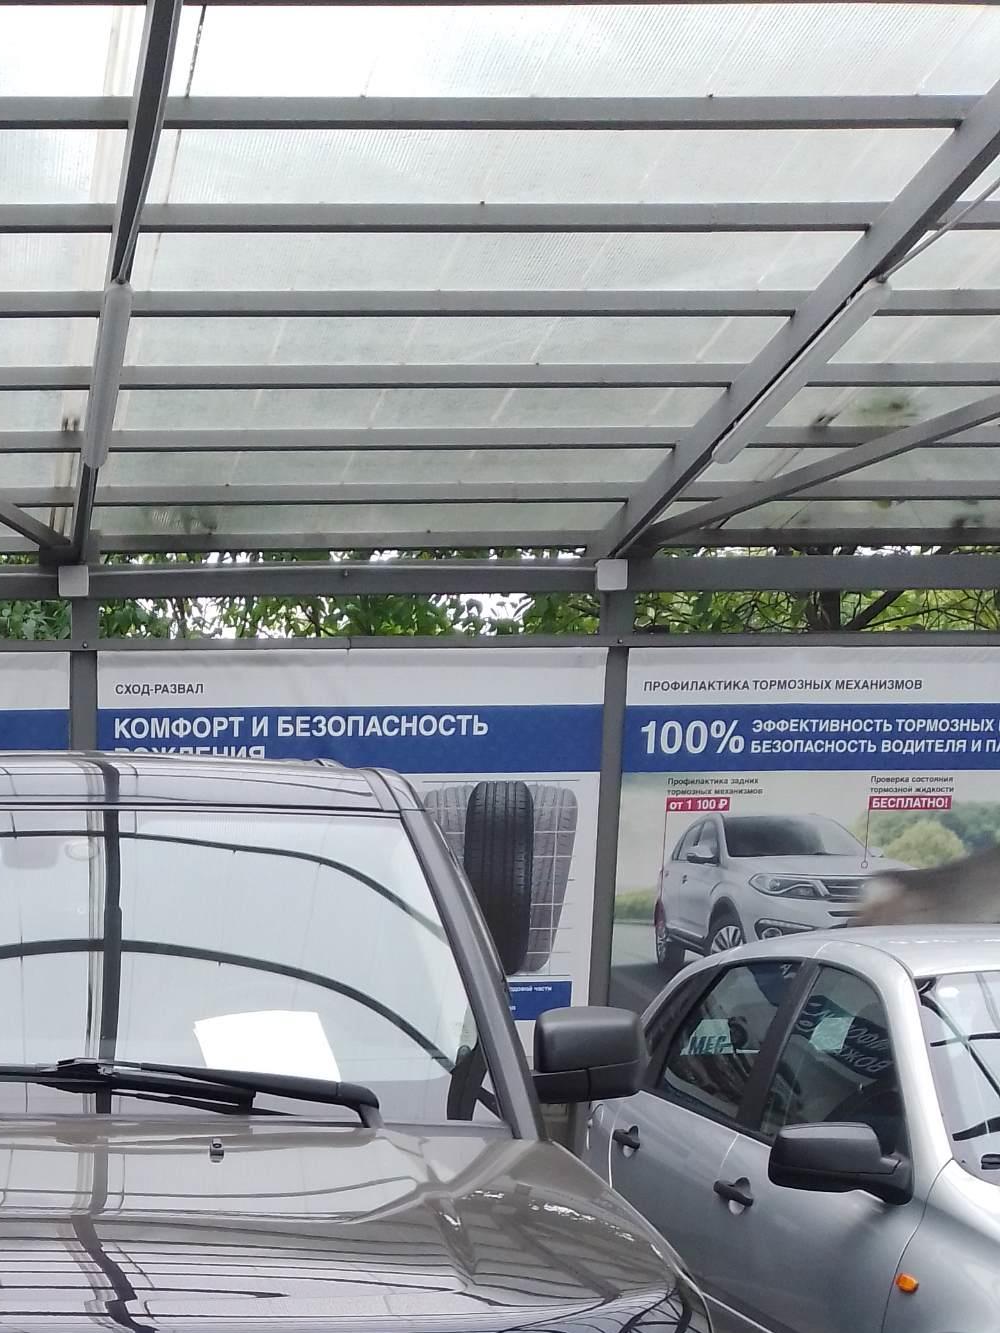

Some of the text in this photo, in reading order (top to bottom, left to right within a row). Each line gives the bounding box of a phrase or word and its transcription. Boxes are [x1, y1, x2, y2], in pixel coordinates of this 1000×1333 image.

[115, 683, 204, 697] СХОД-РАЗВАЛ
[643, 679, 923, 692] ПРОФИЛАКТИКА ТОРМОЗНЫХ МЕХАНИЗМОВ
[114, 713, 488, 739] КОМФОРТ И БЕЗОПАСНОСТЬ
[752, 718, 995, 733] ЭФФЕКТИВНОСТЬ ТОРМОЗНЫХ
[640, 719, 745, 755] 100%
[750, 740, 877, 754] БЕЗОПАСНОСТЬ
[881, 739, 967, 755] ВОДИТЕЛЯ
[971, 739, 982, 753] И
[667, 778, 728, 786] Профилактика
[870, 776, 909, 784] Проверка
[870, 786, 912, 794] тормозной
[669, 801, 683, 810] от
[872, 797, 949, 809] БЕСПЛАТНО!
